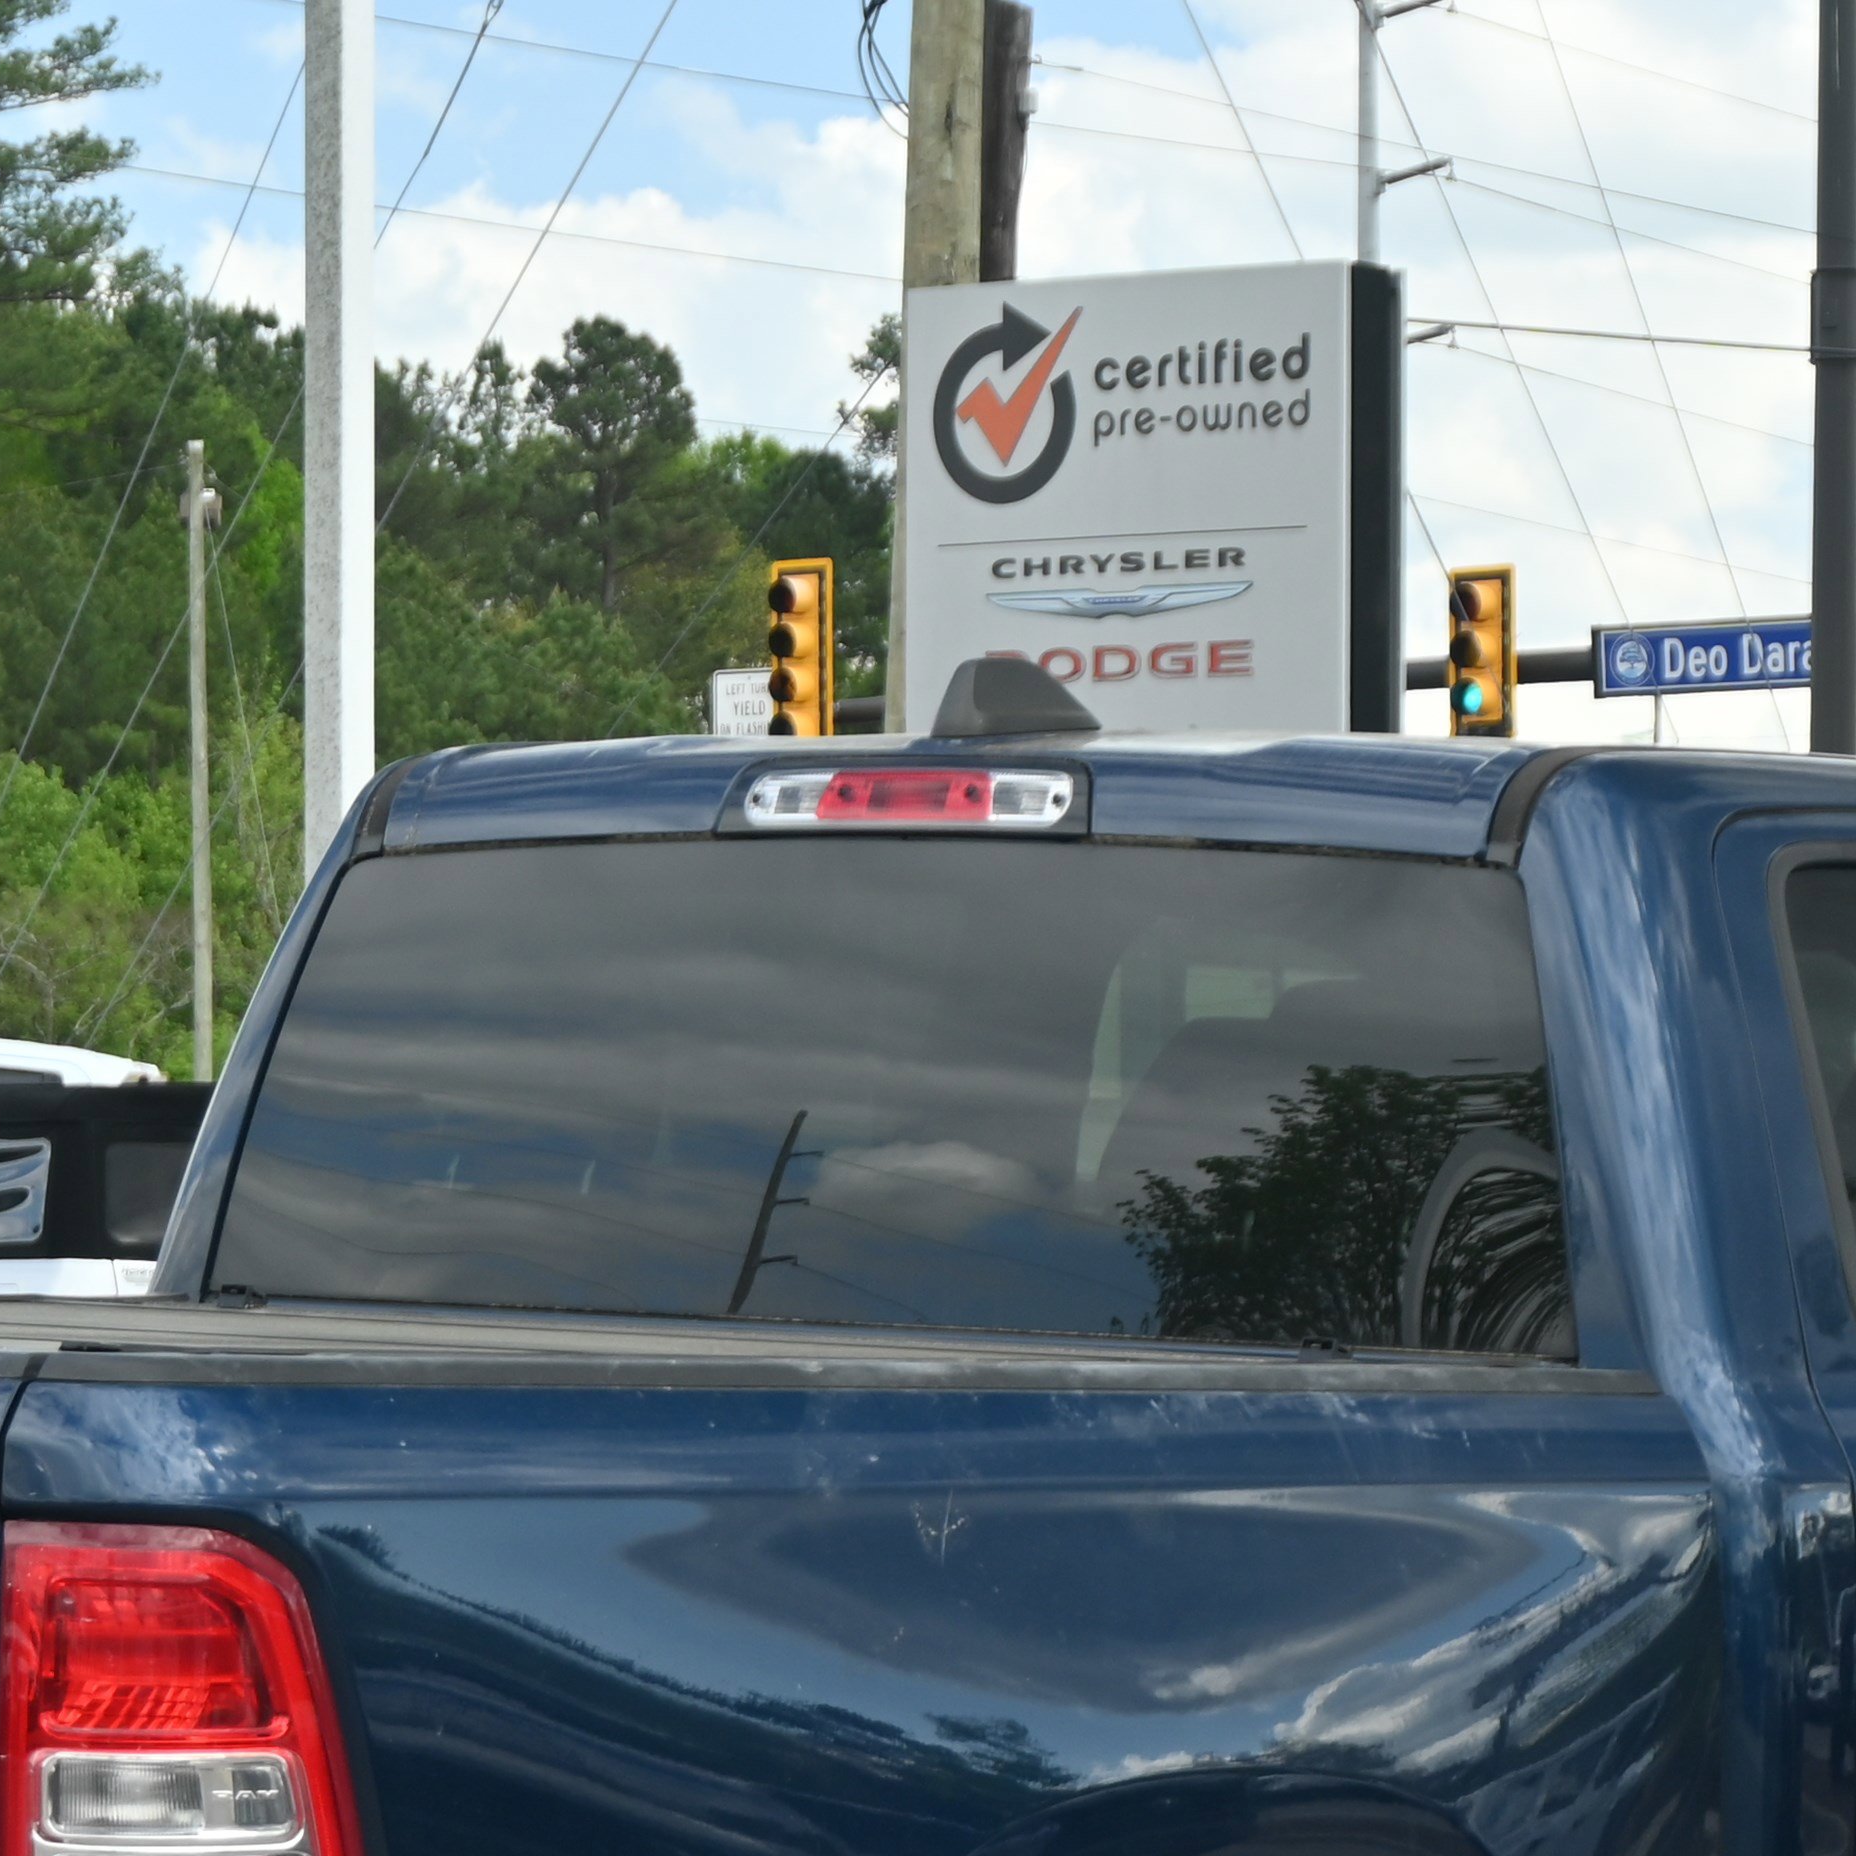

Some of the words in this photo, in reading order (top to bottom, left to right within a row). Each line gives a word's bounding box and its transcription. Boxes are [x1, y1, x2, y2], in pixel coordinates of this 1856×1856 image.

[1093, 331, 1312, 392] certified
[1092, 389, 1312, 447] pre-owned
[991, 546, 1247, 580] CHRYSLER
[985, 639, 1255, 684] ODGE
[1662, 636, 1728, 679] Deo
[733, 700, 766, 716] YIELD
[751, 682, 770, 694] TUR
